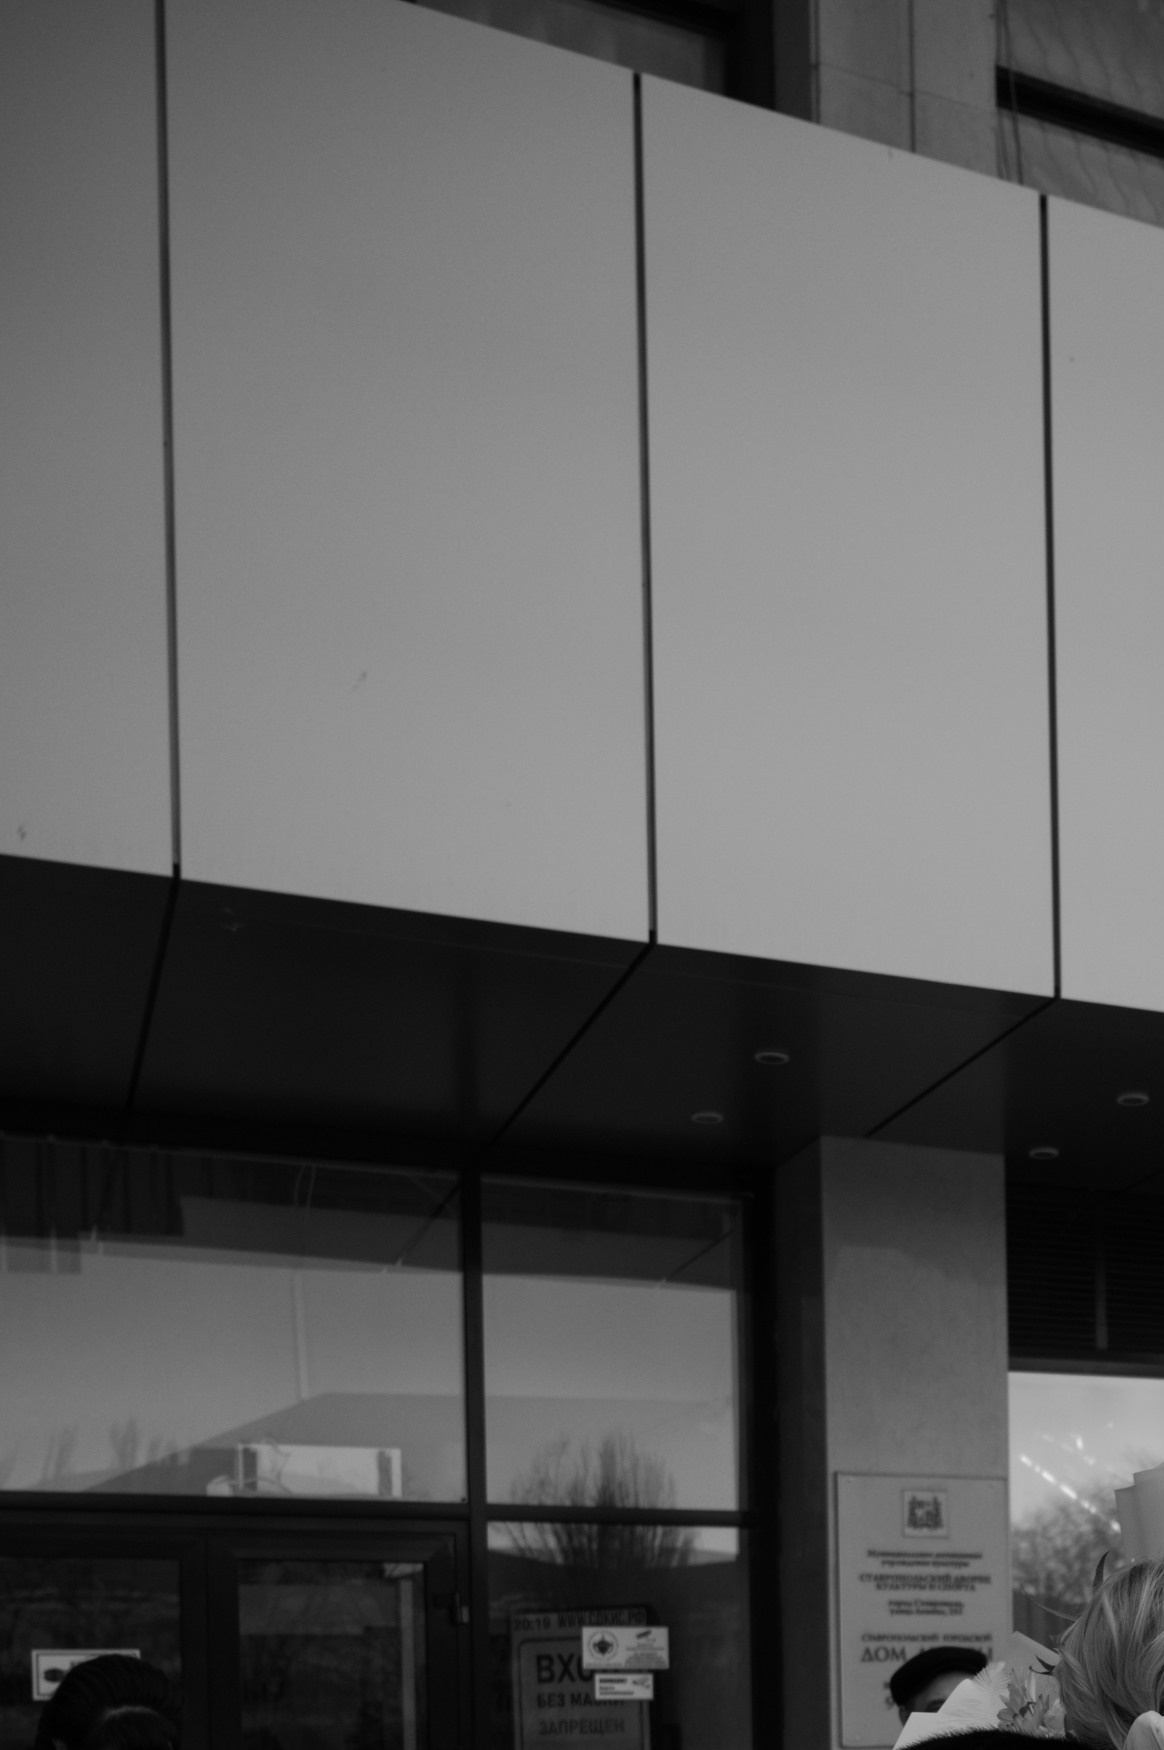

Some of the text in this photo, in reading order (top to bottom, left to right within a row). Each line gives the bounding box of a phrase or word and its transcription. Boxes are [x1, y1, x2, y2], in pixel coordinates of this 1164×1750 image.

[861, 1647, 906, 1662] ДОМ
[537, 1654, 615, 1683] ВХО
[537, 1693, 566, 1708] БЕЗ
[540, 1718, 625, 1736] ЗАПРЕЩЕН
